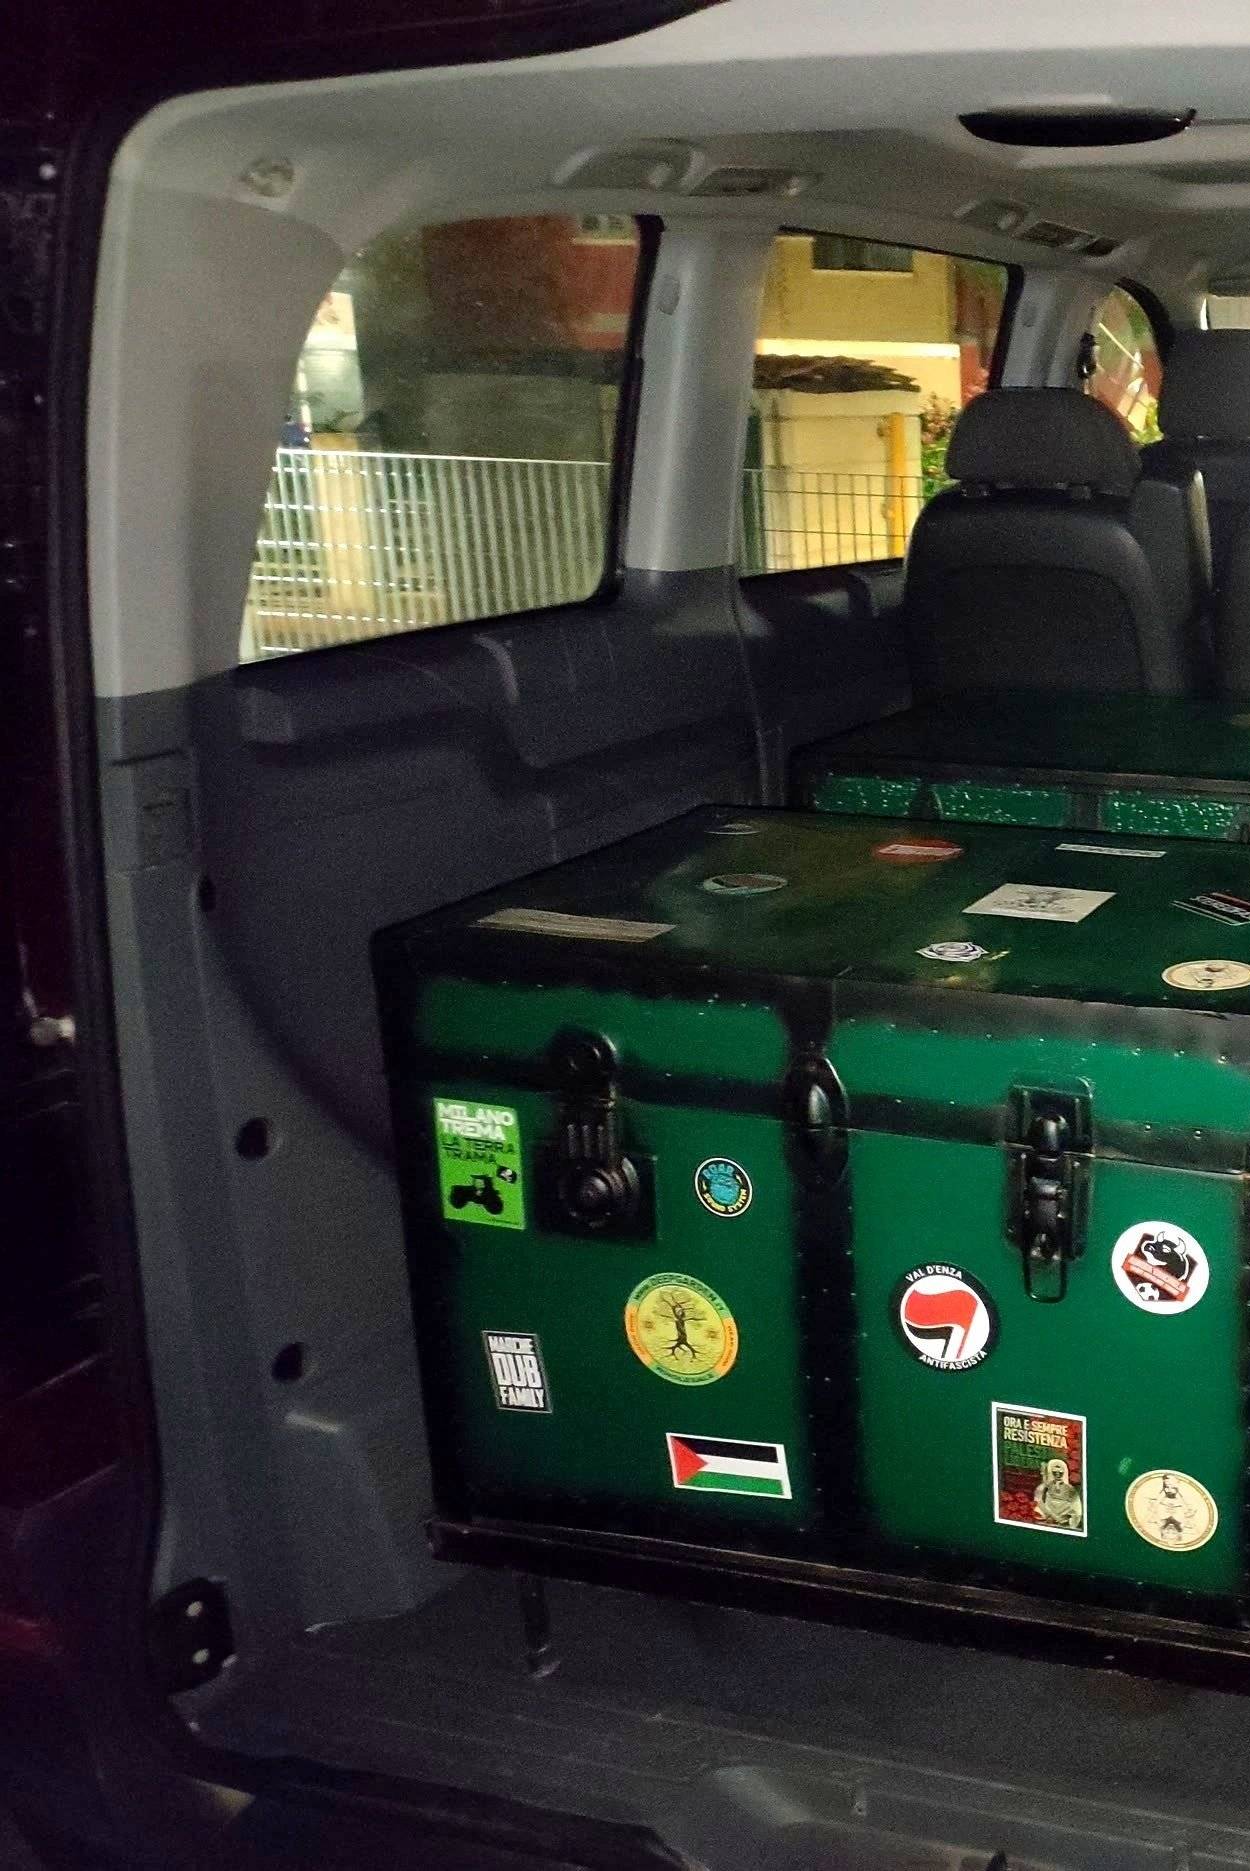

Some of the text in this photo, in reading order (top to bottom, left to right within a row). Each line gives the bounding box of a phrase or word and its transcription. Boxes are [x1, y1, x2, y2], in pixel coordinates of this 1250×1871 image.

[437, 1102, 513, 1127] MILANO
[440, 1118, 506, 1141] TREMA
[905, 1264, 963, 1282] VAL D'ENZA
[491, 1352, 542, 1388] DUB
[918, 1350, 988, 1371] ANTIFASCISTA
[499, 1385, 545, 1408] FAMILY
[1003, 1416, 1023, 1430] ORA
[1030, 1421, 1069, 1437] SEMPRE
[1003, 1428, 1068, 1449] RESISTENZA
